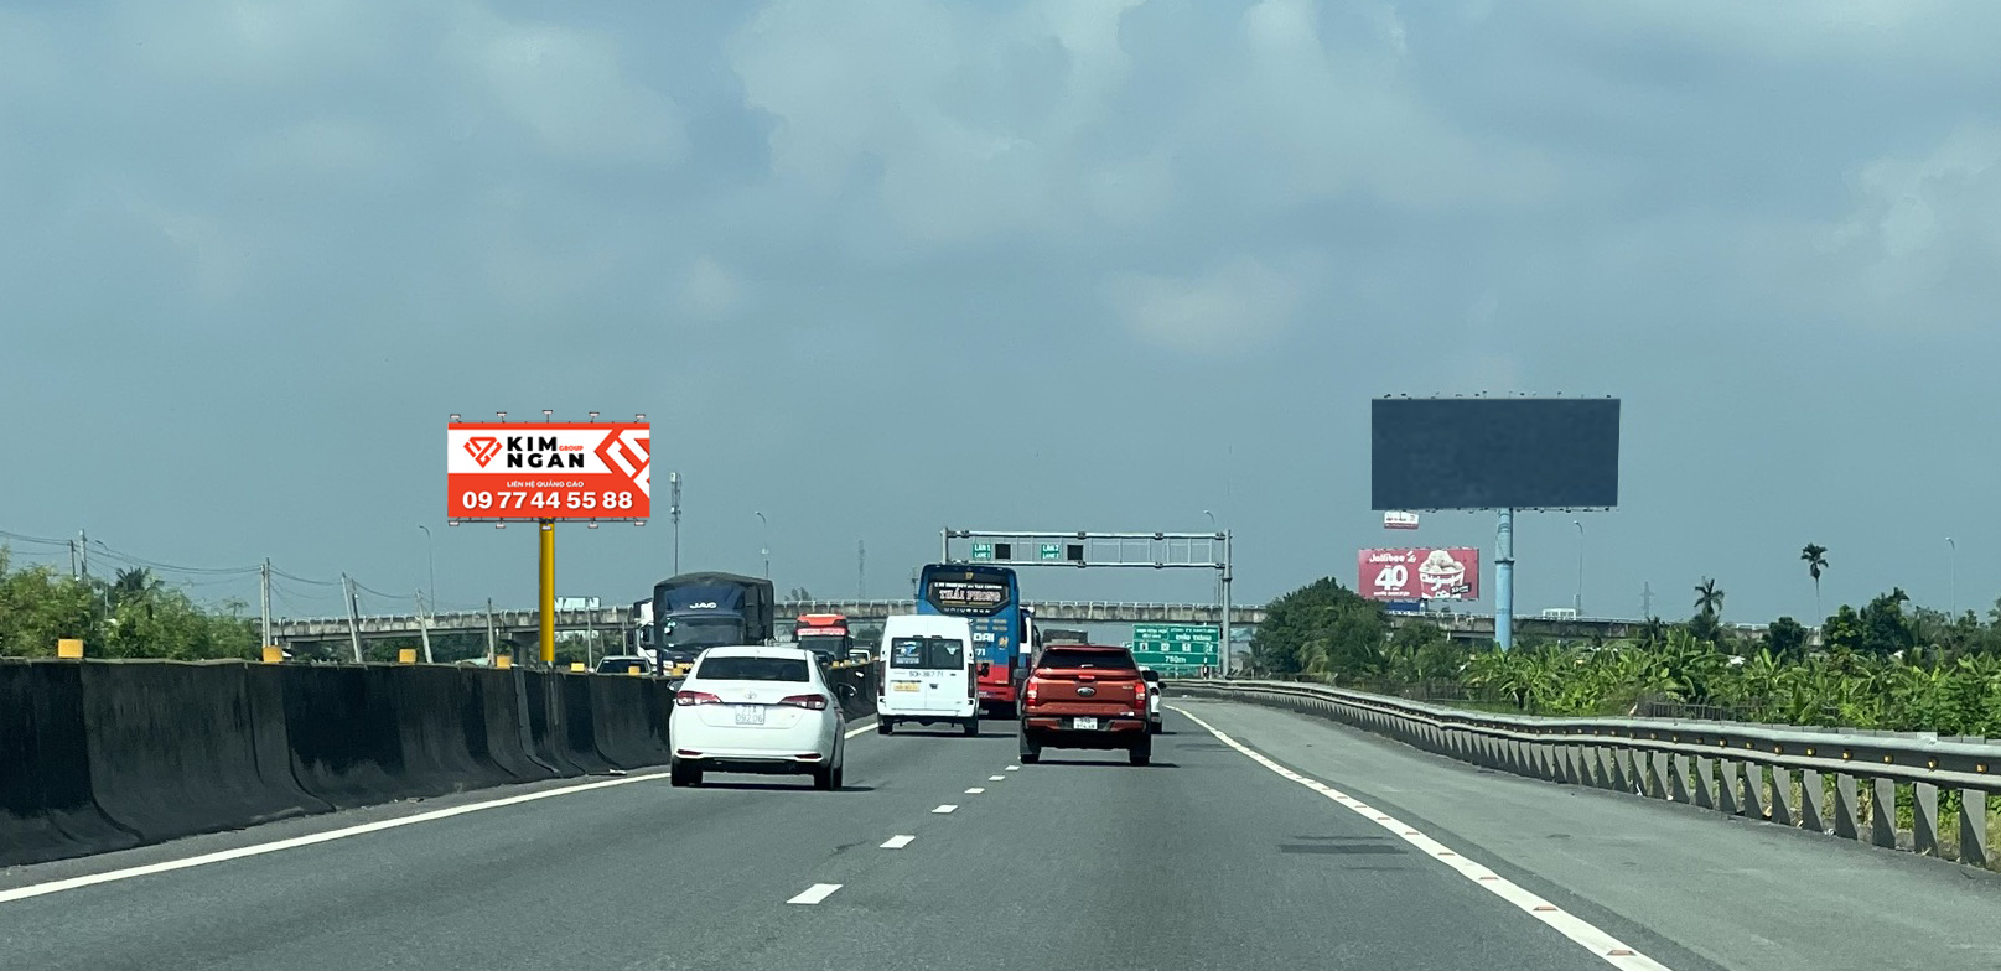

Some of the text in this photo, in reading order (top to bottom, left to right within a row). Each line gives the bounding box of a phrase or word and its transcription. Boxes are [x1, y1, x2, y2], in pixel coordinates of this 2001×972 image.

[507, 437, 557, 451] KIM
[507, 453, 584, 468] NGAN
[462, 491, 633, 509] 09 77 44 55 88
[1374, 565, 1408, 591] 40
